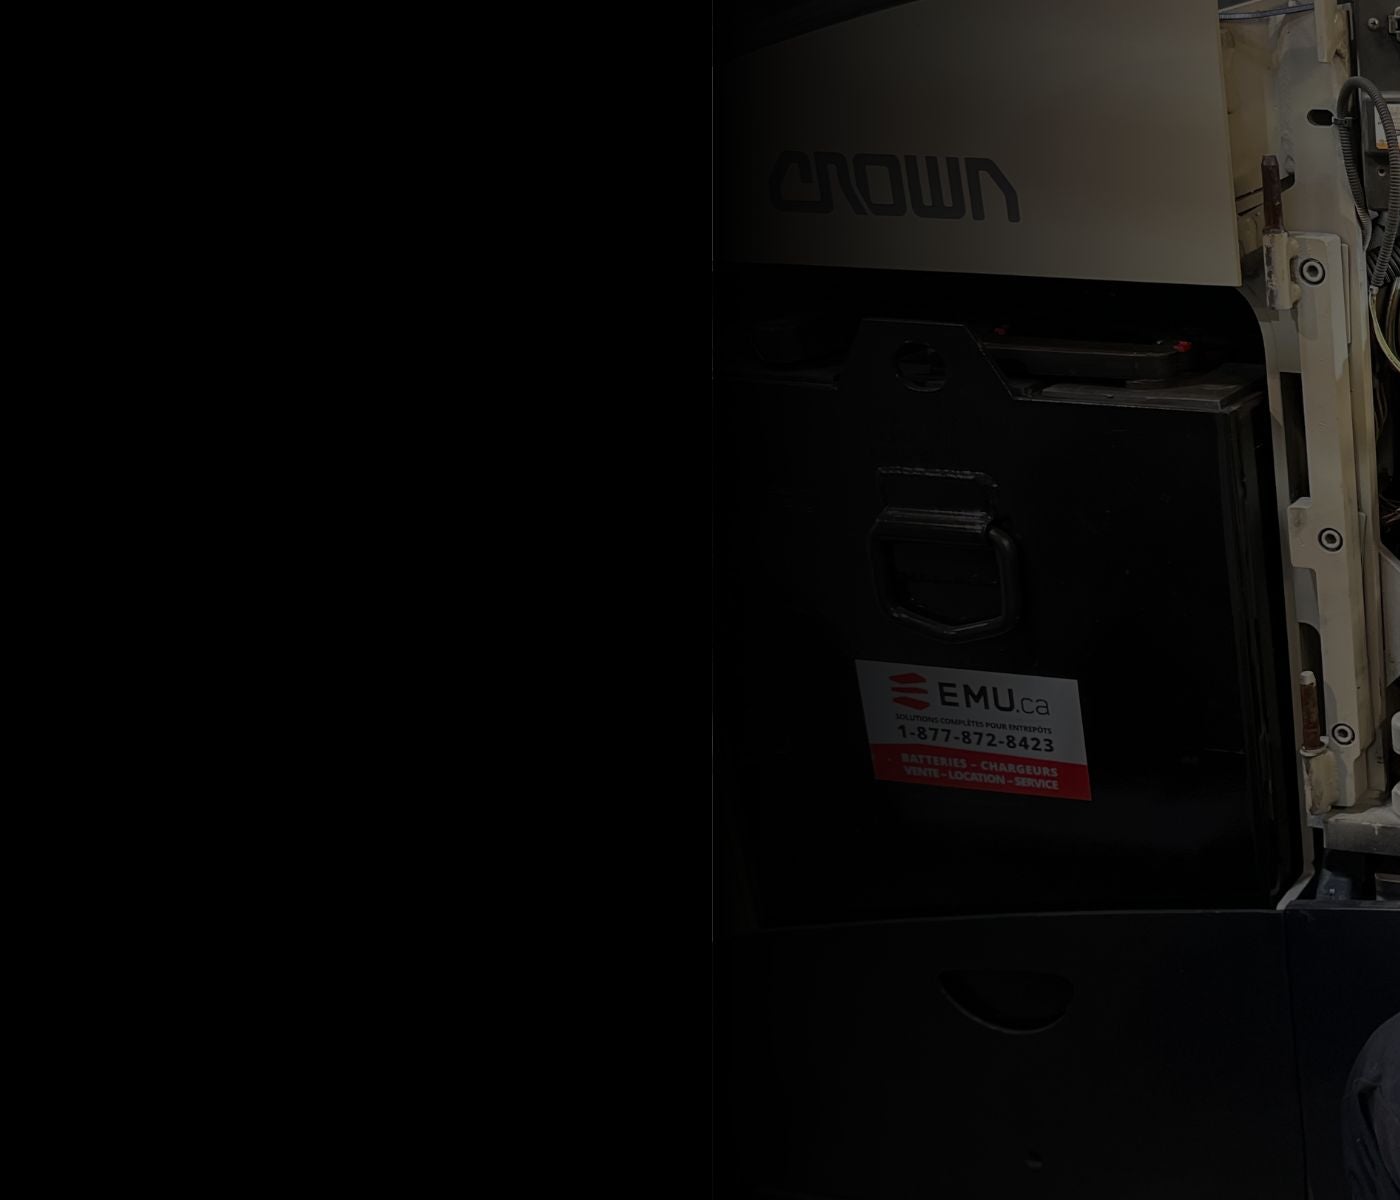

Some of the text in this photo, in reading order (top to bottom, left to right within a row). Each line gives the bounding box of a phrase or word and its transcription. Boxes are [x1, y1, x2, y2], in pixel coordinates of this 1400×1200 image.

[769, 151, 1021, 222] CROWN
[938, 682, 1051, 716] EMU.ca
[896, 713, 938, 724] SOLUTIONS
[985, 721, 1008, 730] POUR
[898, 725, 1054, 752] 1-877-872-8423
[900, 753, 968, 770] BATTERIES
[980, 760, 1058, 777] CHARGEURS
[904, 766, 939, 778] VENTE
[949, 770, 1006, 785] LOCATION
[1015, 777, 1060, 791] SERVICE
